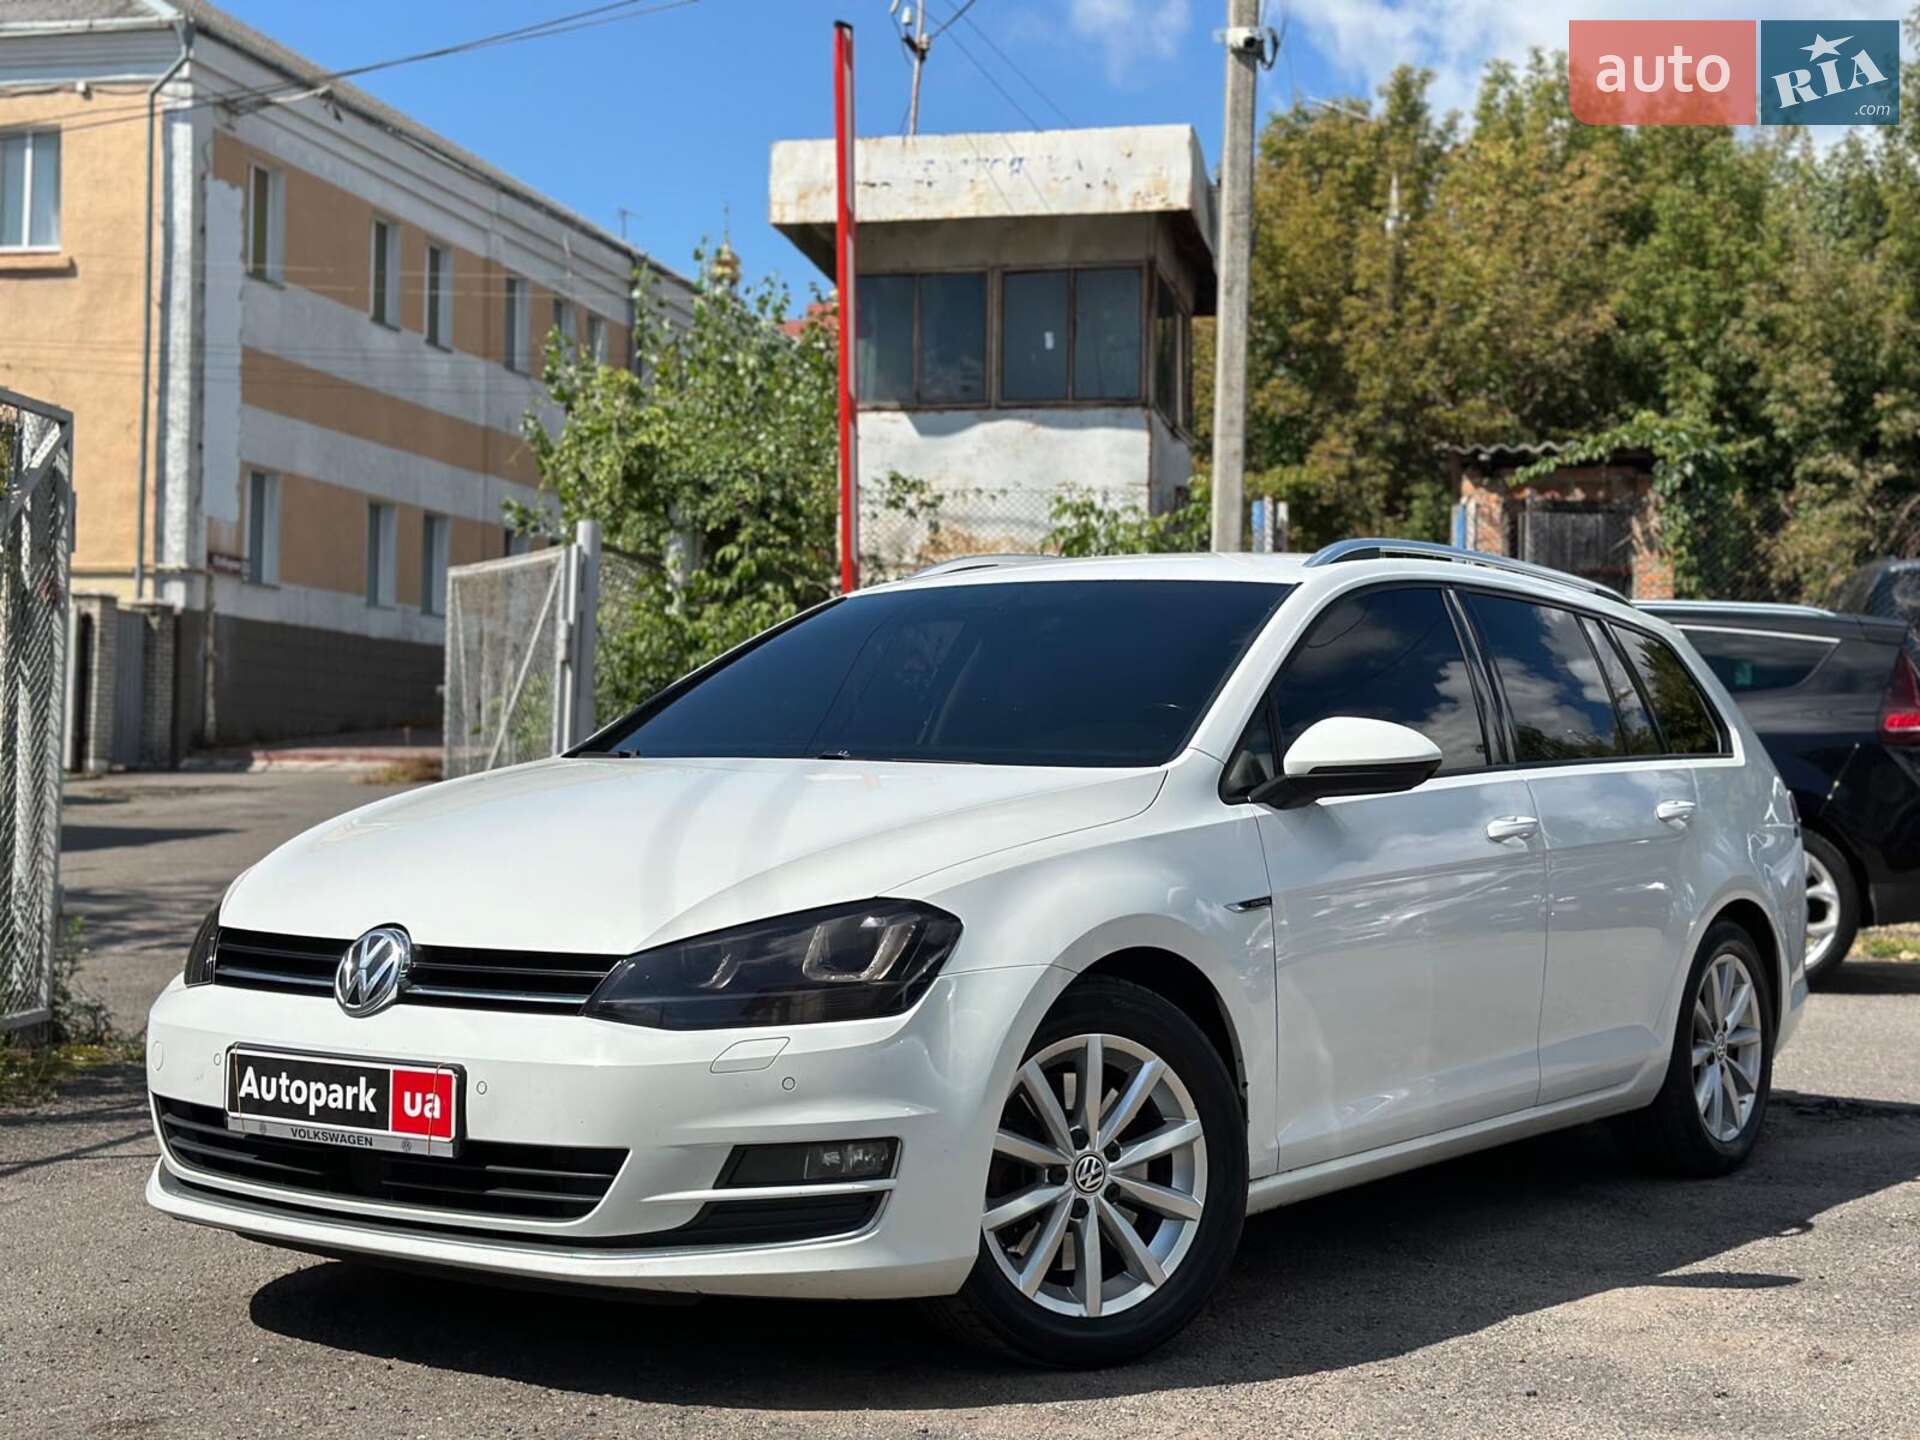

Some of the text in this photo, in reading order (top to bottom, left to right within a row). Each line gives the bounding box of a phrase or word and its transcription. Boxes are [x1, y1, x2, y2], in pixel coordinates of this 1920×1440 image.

[239, 1066, 441, 1119] Autopark ua
[290, 1127, 374, 1147] VOLKSWAGEN
